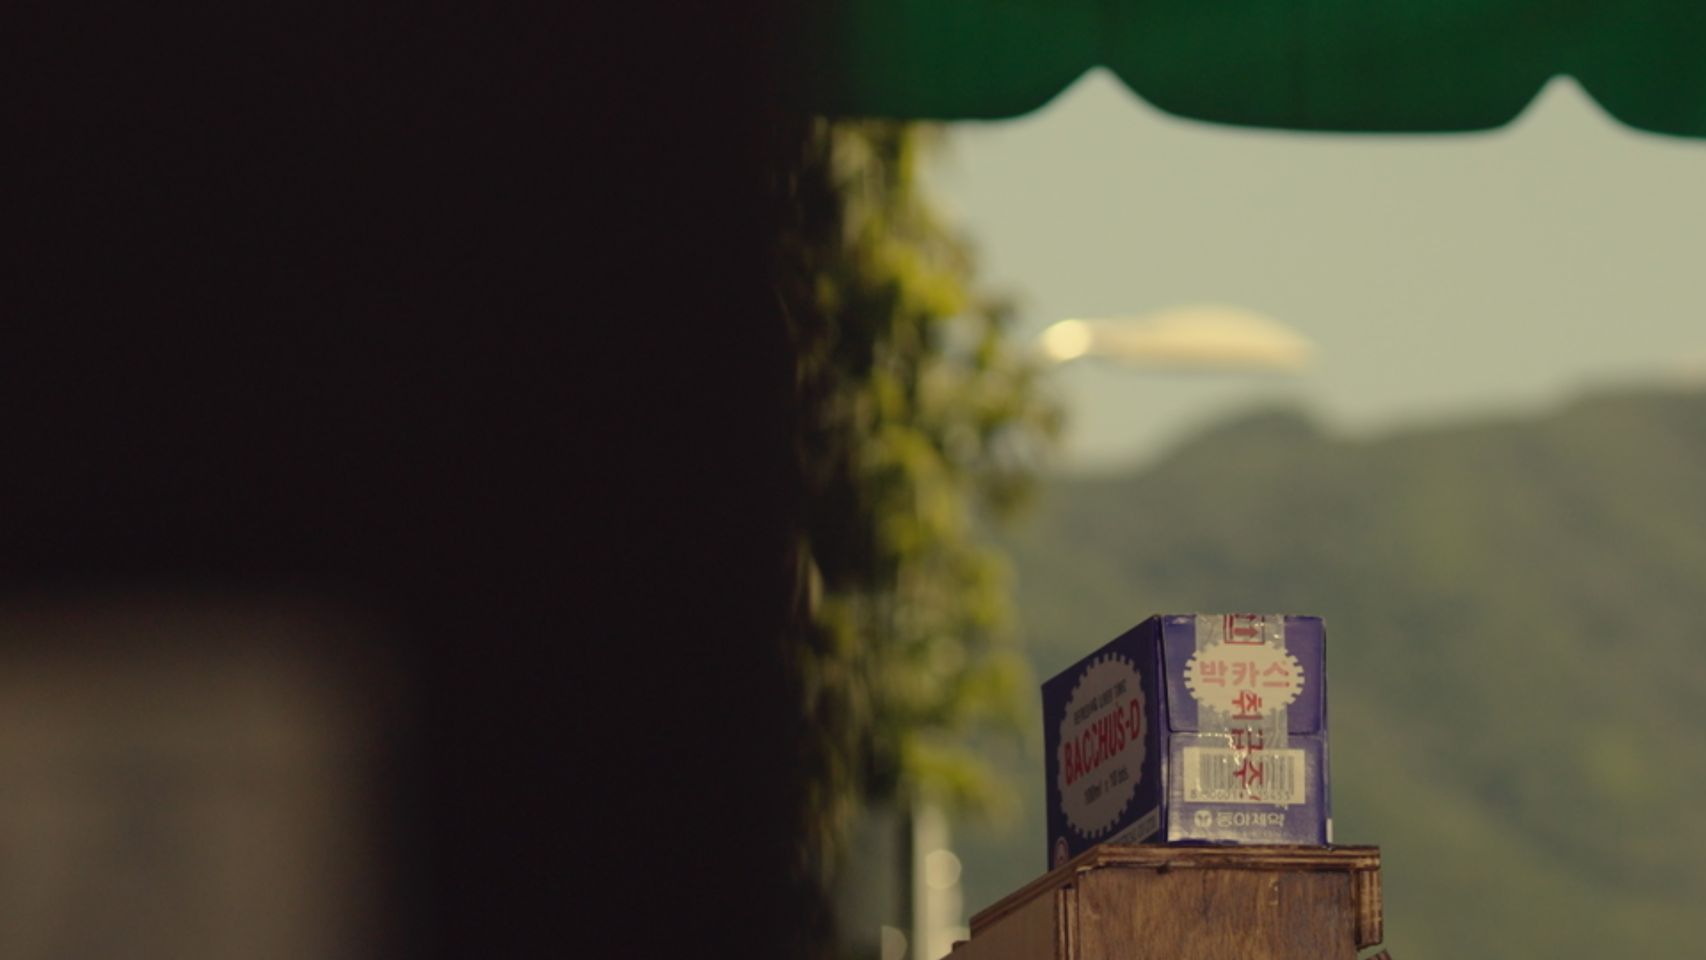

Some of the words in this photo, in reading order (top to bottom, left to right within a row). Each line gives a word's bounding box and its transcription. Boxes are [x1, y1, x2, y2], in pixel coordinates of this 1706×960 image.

[1199, 660, 1291, 688] 박카스
[1063, 698, 1141, 786] BACCHUS-D
[1232, 690, 1264, 801] 취급주
[1216, 811, 1285, 829] 동아제약
